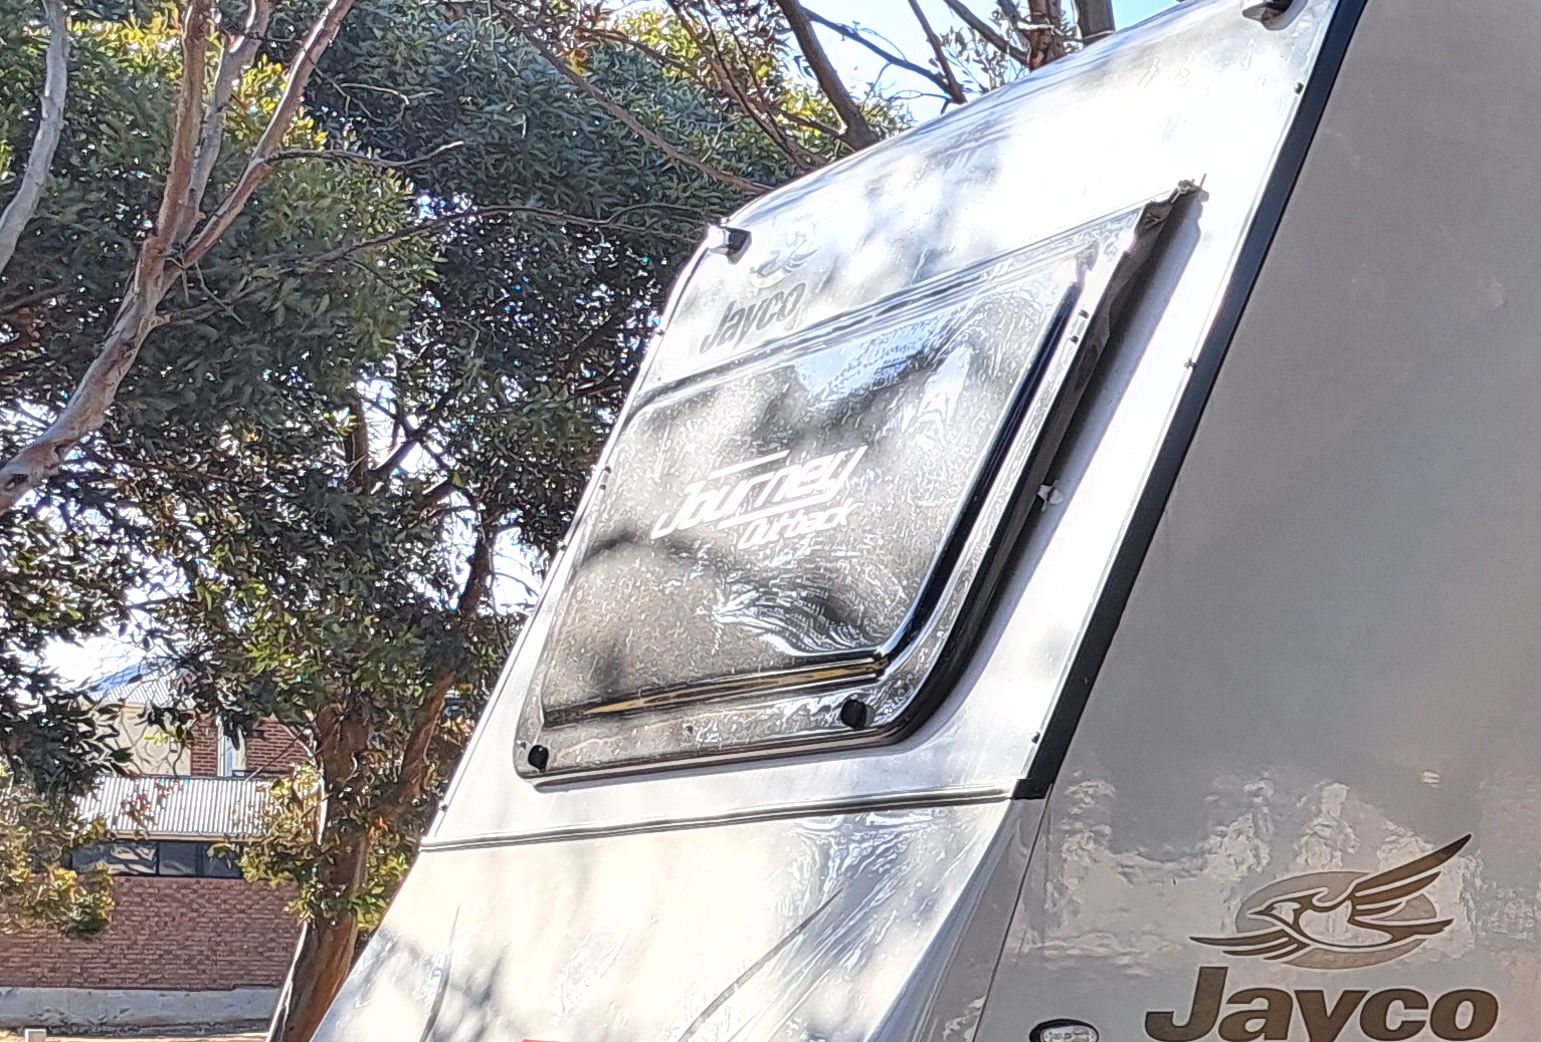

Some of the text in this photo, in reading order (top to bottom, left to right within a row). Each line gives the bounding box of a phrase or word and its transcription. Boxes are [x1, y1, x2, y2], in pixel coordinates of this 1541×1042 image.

[699, 282, 806, 354] Jayco
[651, 446, 868, 540] Journey
[737, 498, 860, 549] Outback
